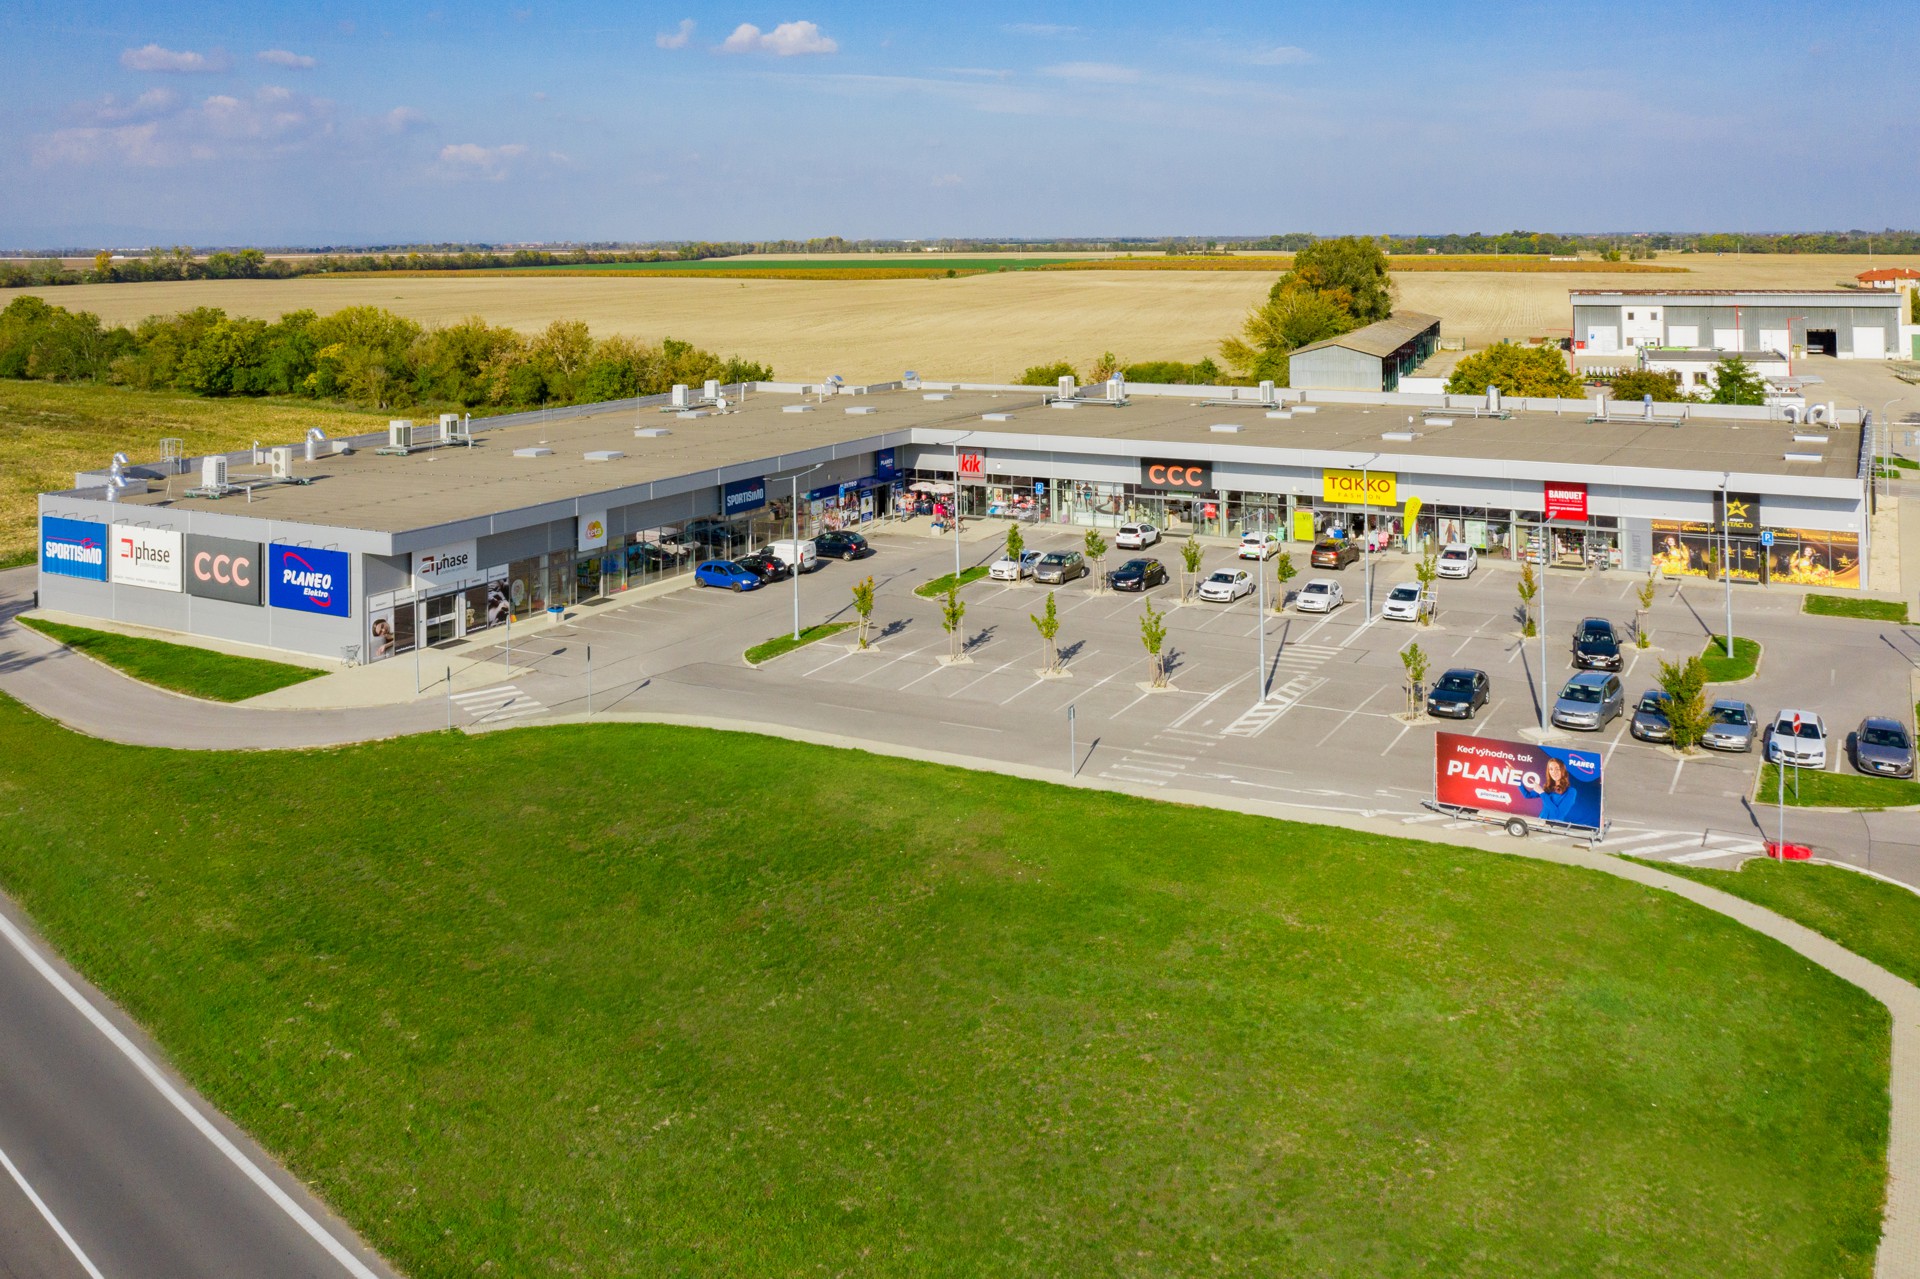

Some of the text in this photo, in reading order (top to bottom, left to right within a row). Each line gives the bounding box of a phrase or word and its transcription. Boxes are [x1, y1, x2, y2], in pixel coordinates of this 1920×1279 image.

[1149, 465, 1203, 487] CCC
[727, 488, 764, 507] SPORTISIMO
[1548, 490, 1583, 500] BANQUET
[46, 541, 102, 565] SPORTISIMO
[135, 541, 170, 565] phase
[194, 551, 250, 587] CCC
[283, 569, 332, 590] PLANEO
[303, 588, 329, 598] Elektro
[1457, 744, 1533, 763] Keď výhodne, tak
[1568, 759, 1595, 769] PLANEO
[1447, 759, 1541, 789] PLANEO
